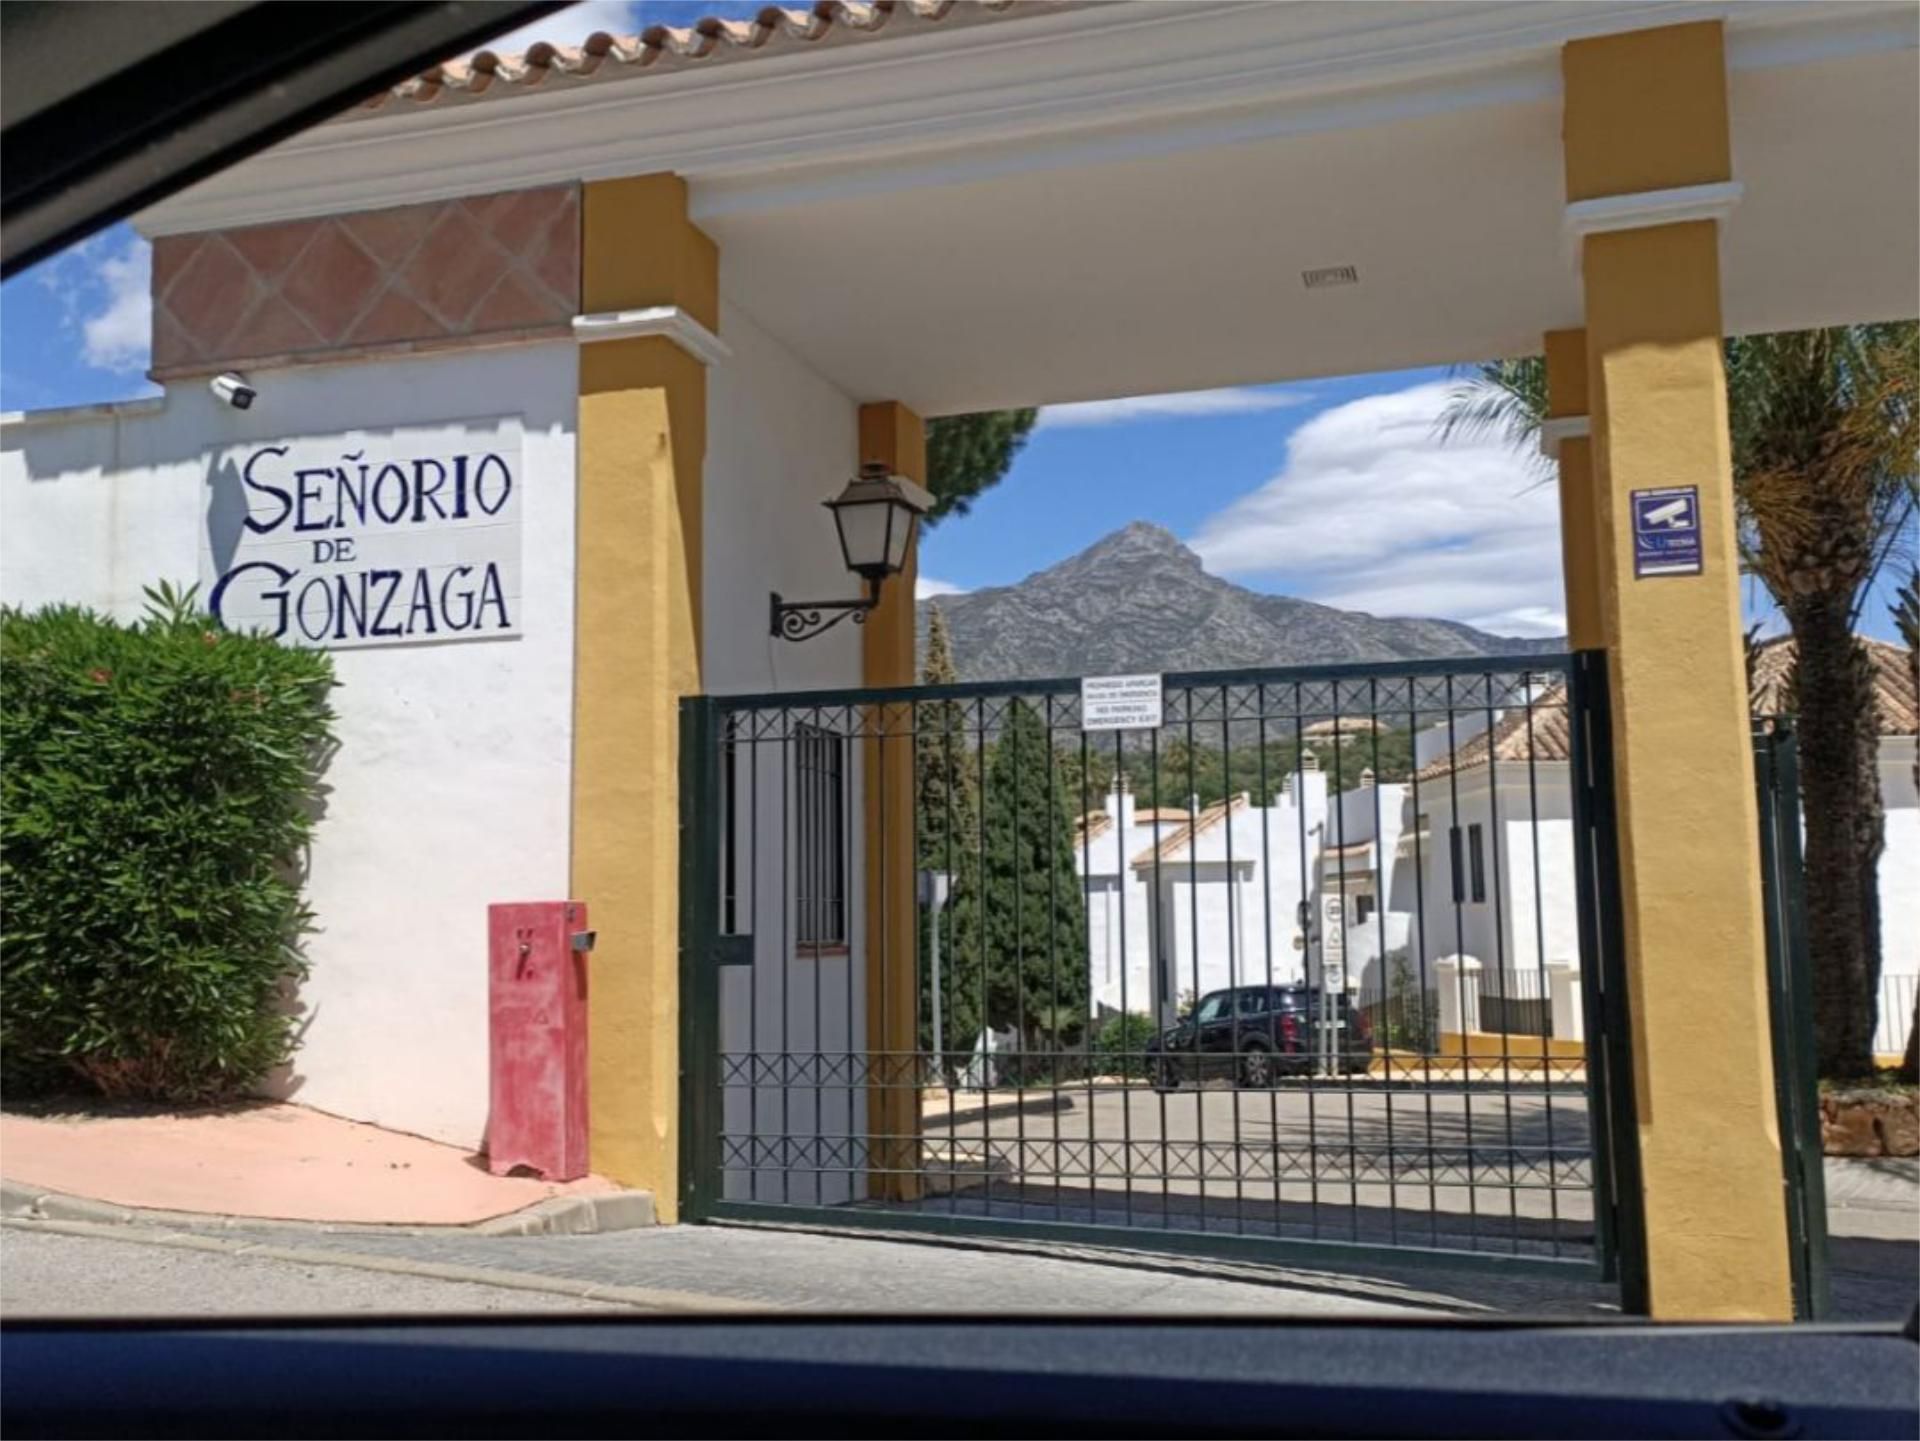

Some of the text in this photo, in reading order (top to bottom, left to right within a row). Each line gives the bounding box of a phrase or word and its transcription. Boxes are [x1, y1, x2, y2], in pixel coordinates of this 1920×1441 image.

[243, 446, 511, 534] SEÑORIO
[312, 537, 356, 563] DE
[209, 562, 511, 641] GONZAGA
